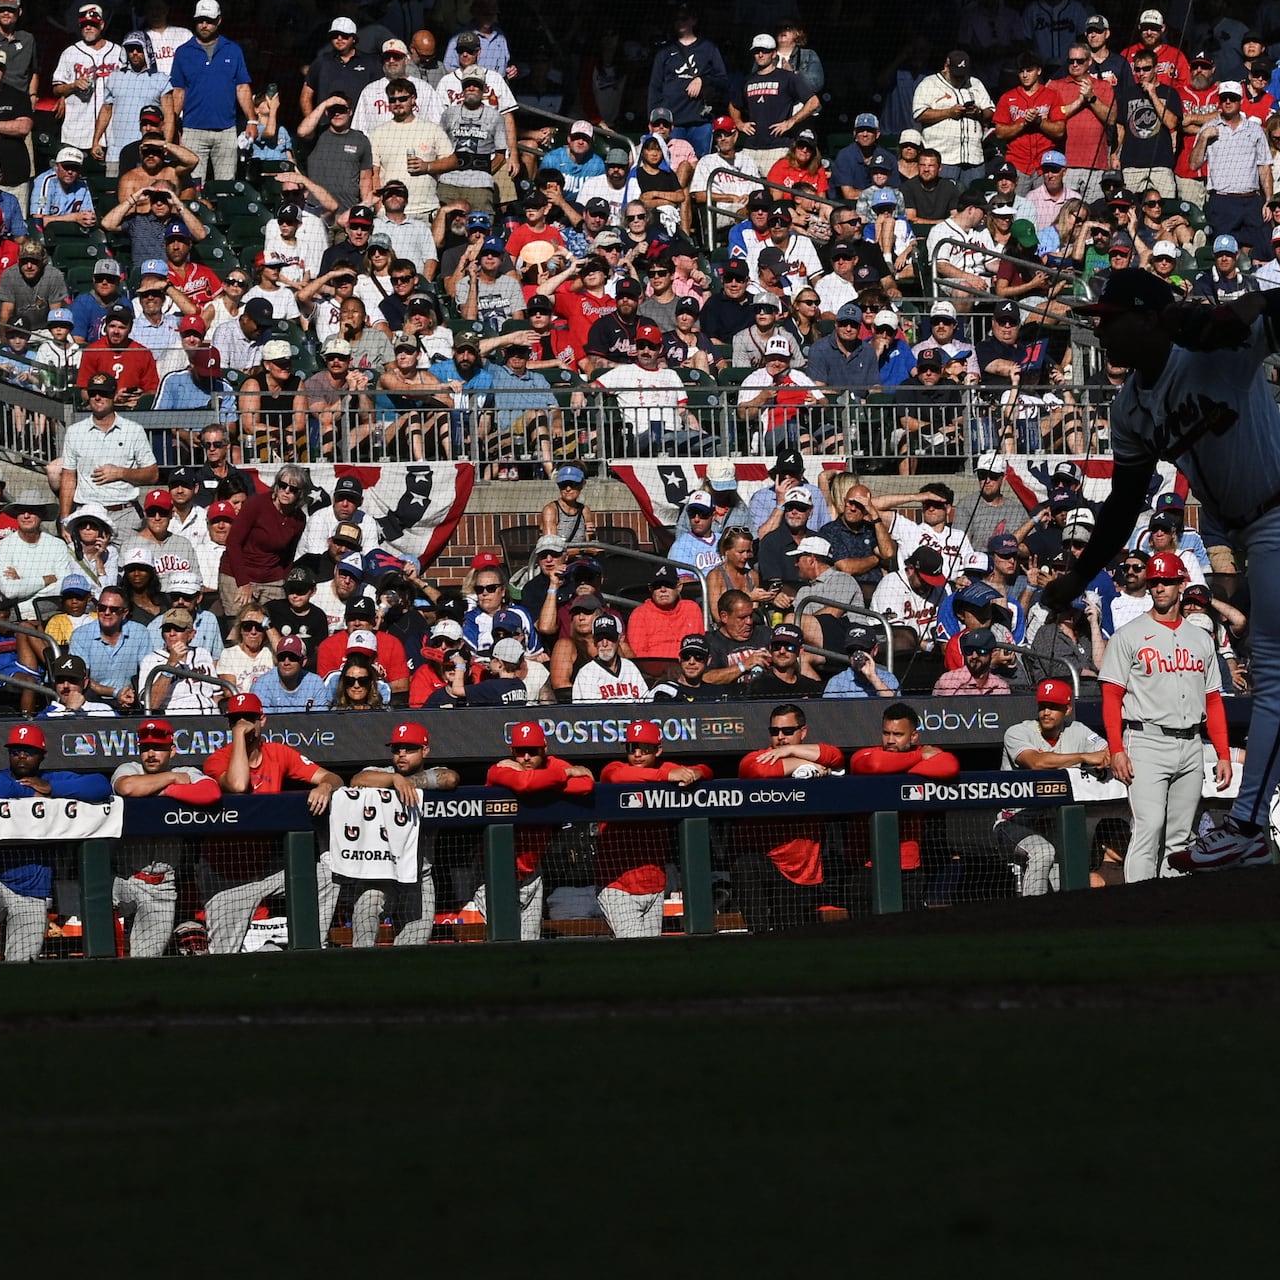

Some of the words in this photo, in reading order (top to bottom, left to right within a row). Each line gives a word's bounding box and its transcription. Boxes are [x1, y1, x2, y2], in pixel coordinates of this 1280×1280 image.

[452, 129, 487, 138] CHAMPIONS
[1045, 683, 1053, 695] P
[237, 695, 246, 706] P
[19, 727, 28, 739] P
[399, 726, 408, 737] P
[521, 726, 530, 738] P
[634, 725, 643, 736] P
[701, 723, 744, 734] 2026
[749, 789, 805, 804] abbvie
[924, 781, 1034, 801] POSTSEASON
[1036, 783, 1067, 793] 2026
[486, 803, 518, 813] 2026
